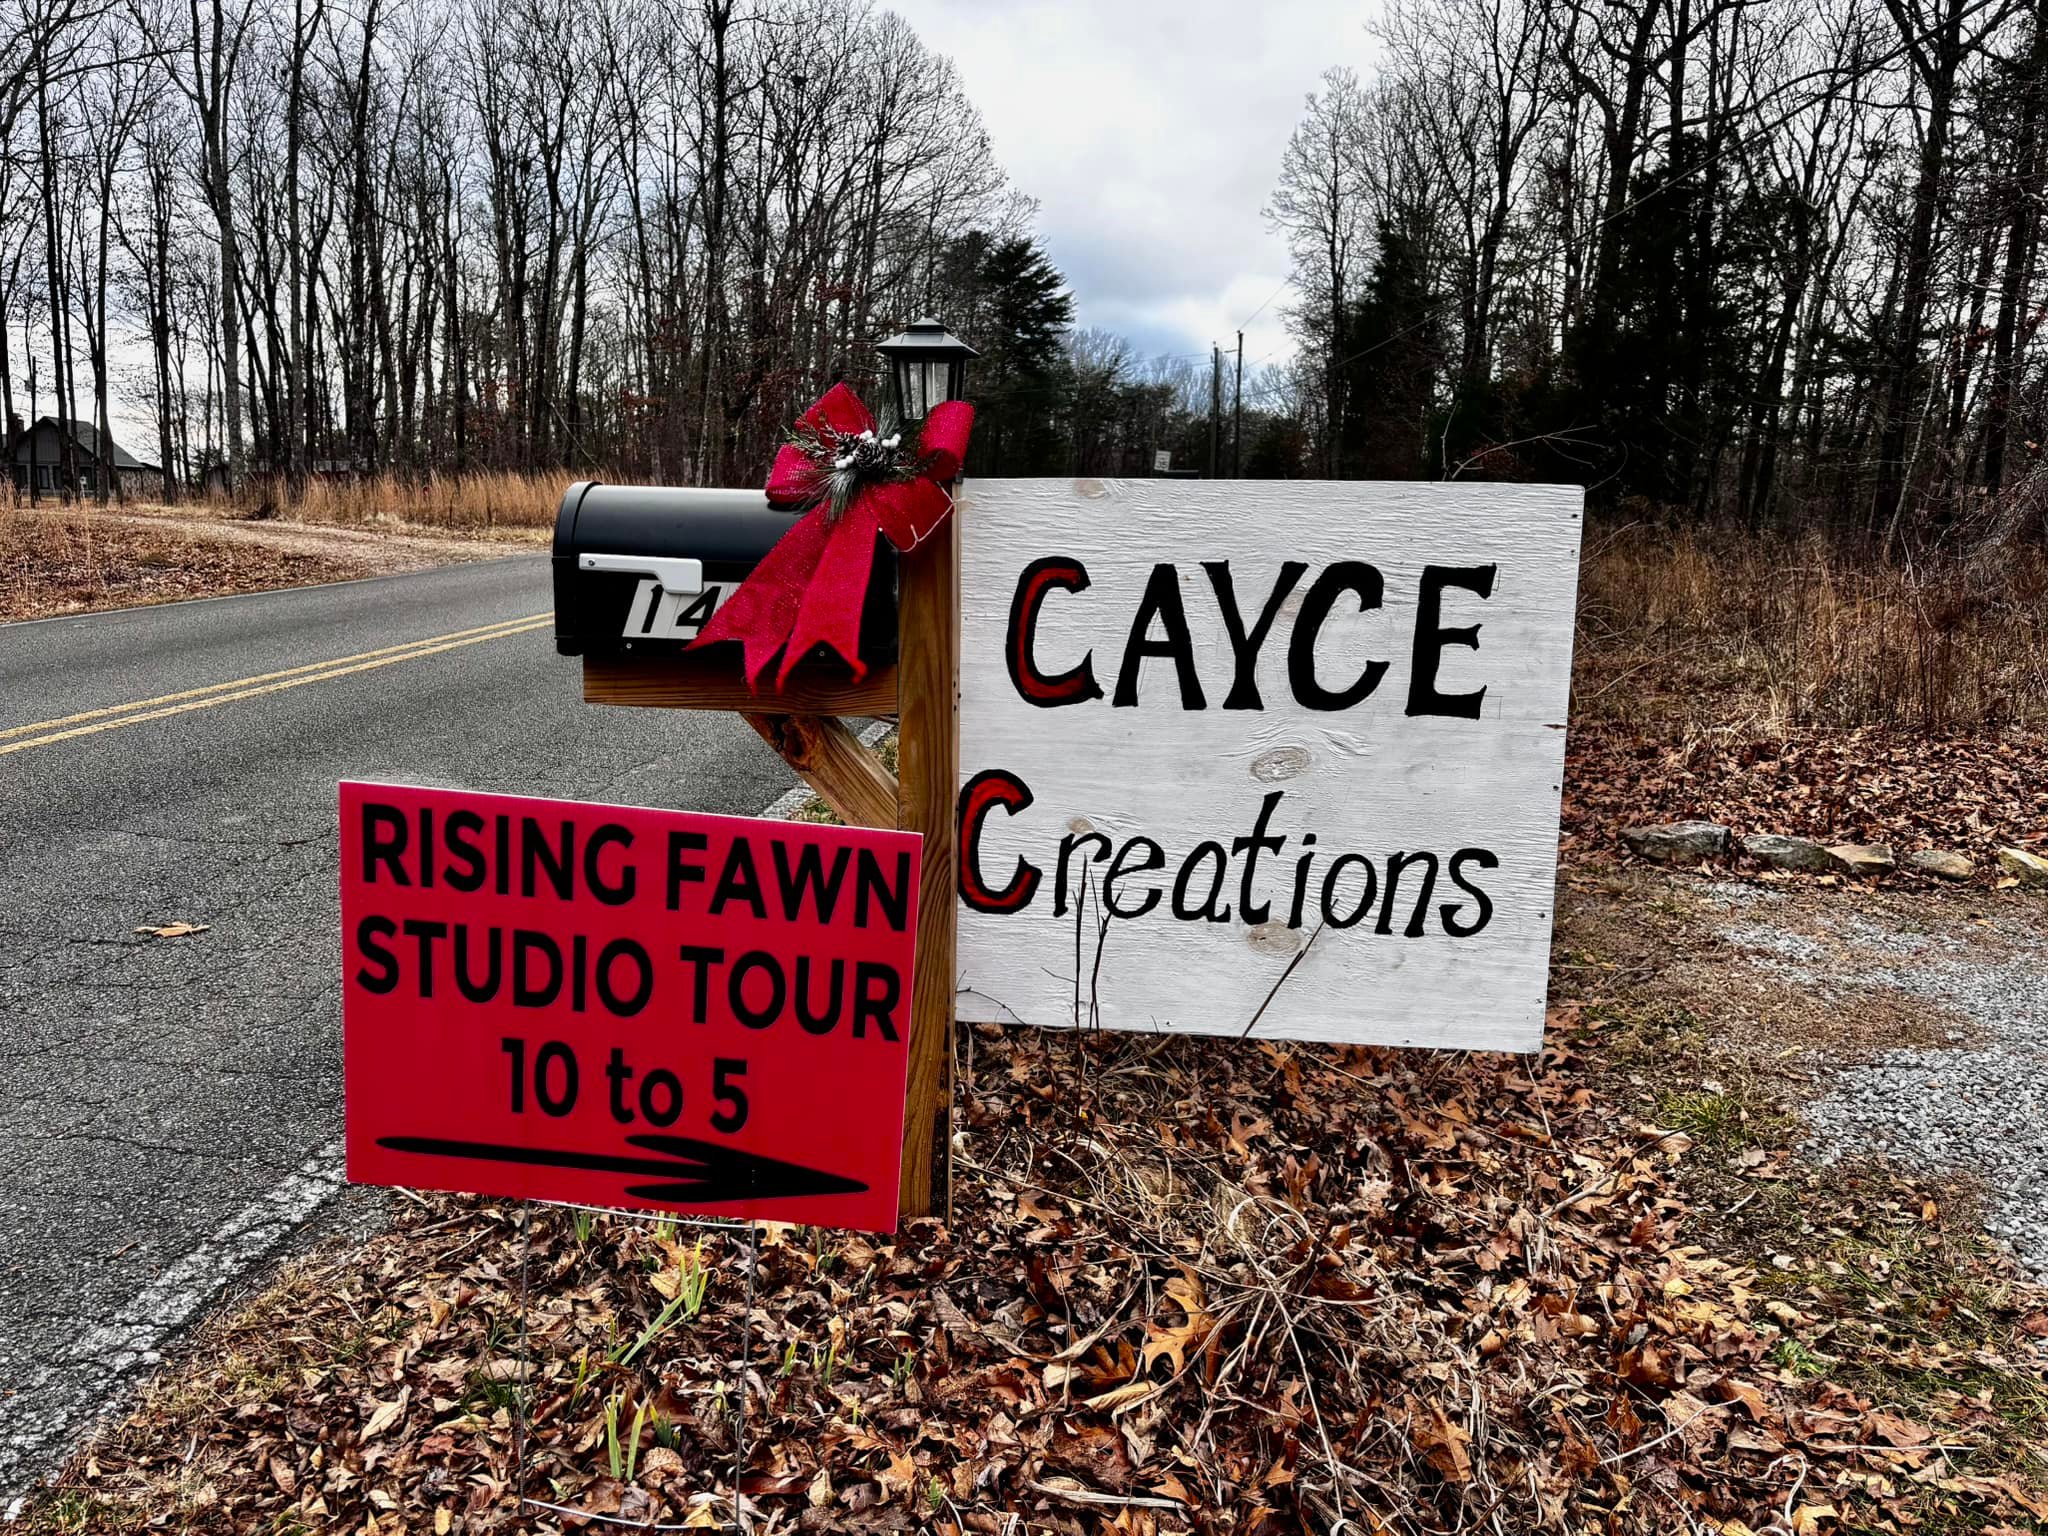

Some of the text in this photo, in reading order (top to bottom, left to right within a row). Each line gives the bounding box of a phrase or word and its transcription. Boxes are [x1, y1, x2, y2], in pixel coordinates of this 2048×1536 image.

[1005, 555, 1498, 721] CAYCE
[362, 803, 911, 932] RISING FAWN
[957, 768, 1499, 938] Creations
[356, 915, 901, 1042] STUDIO TOUR
[501, 1037, 749, 1134] 10 to 5
